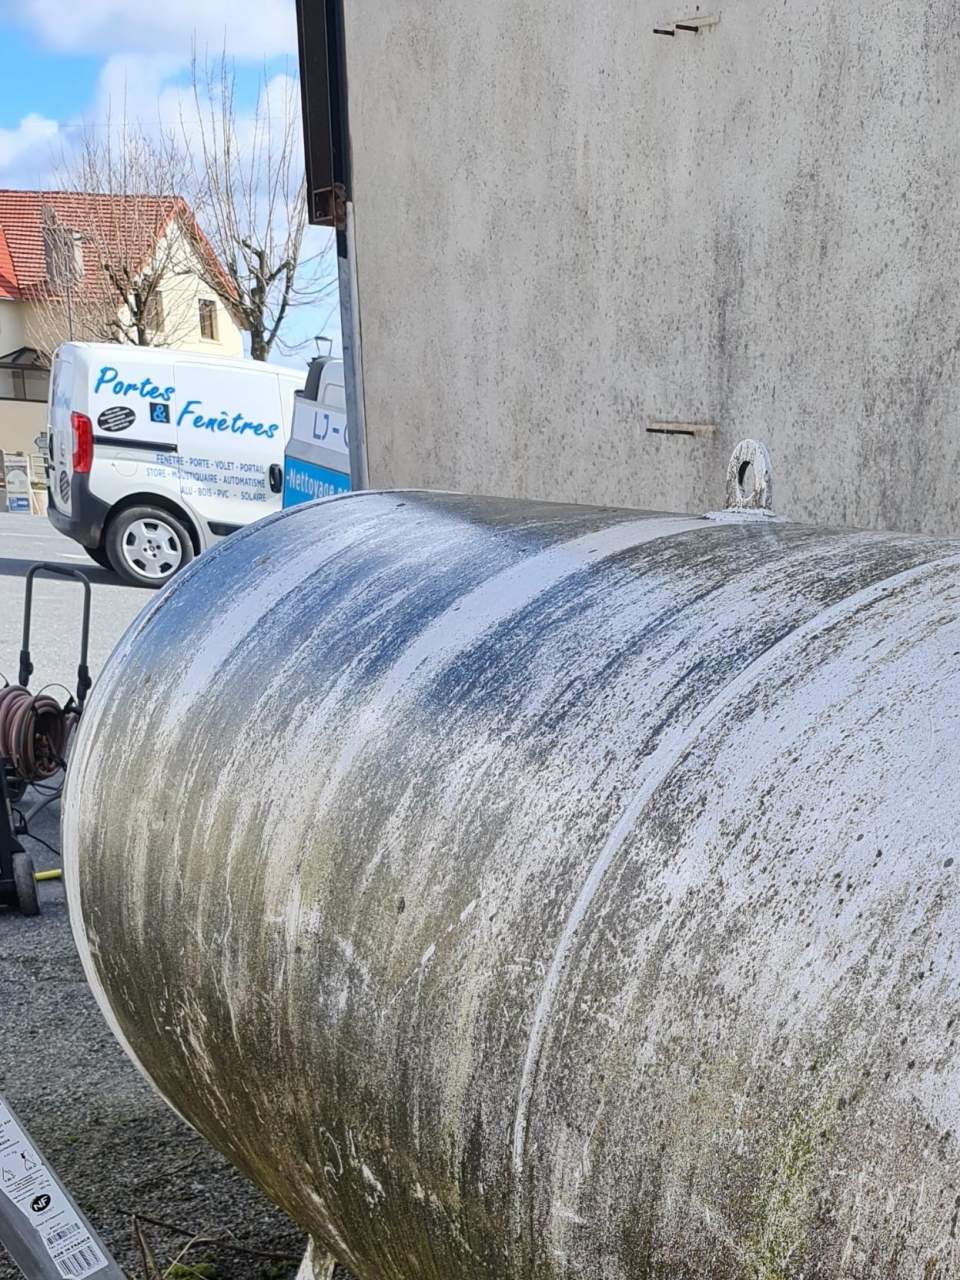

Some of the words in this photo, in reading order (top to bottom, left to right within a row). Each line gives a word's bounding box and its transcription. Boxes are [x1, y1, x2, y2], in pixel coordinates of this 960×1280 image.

[94, 366, 176, 402] Portes
[153, 404, 168, 423] &
[176, 400, 279, 439] Fenêtres
[189, 457, 210, 469] PORTE
[215, 460, 234, 471] VOLET
[223, 475, 265, 489] AUTOMATISME
[33, 1195, 49, 1211] NF
